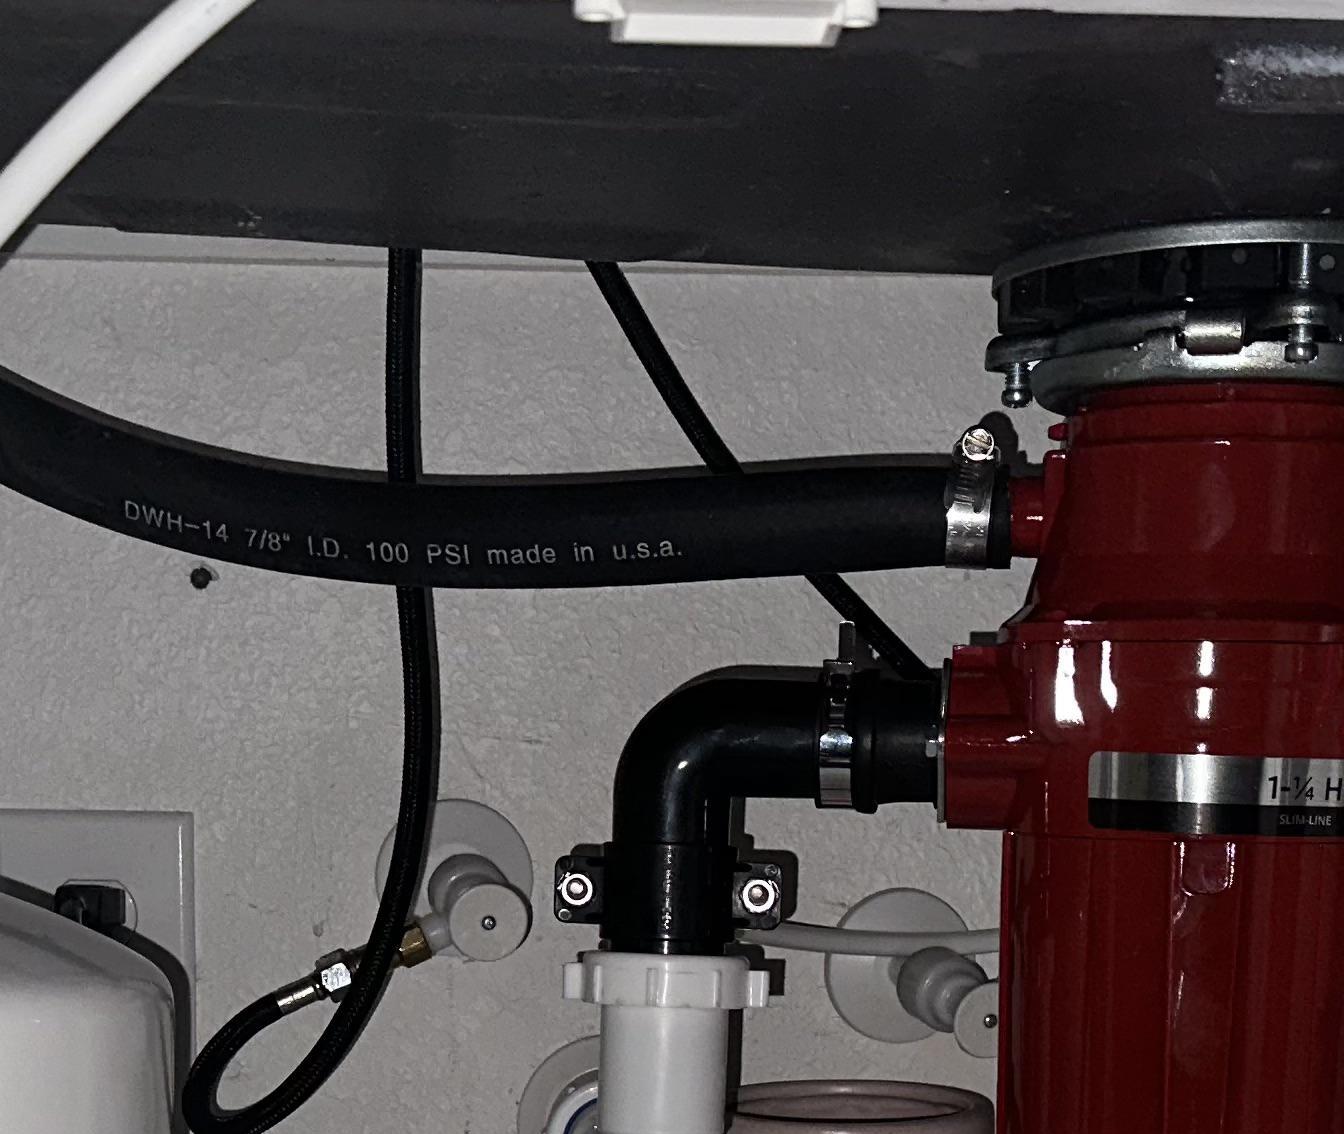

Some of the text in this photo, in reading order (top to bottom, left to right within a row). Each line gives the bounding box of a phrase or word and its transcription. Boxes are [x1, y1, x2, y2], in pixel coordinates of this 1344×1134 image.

[124, 500, 683, 565] DWH-14 7/8" I.D. 100 PSI made in u.s.a.
